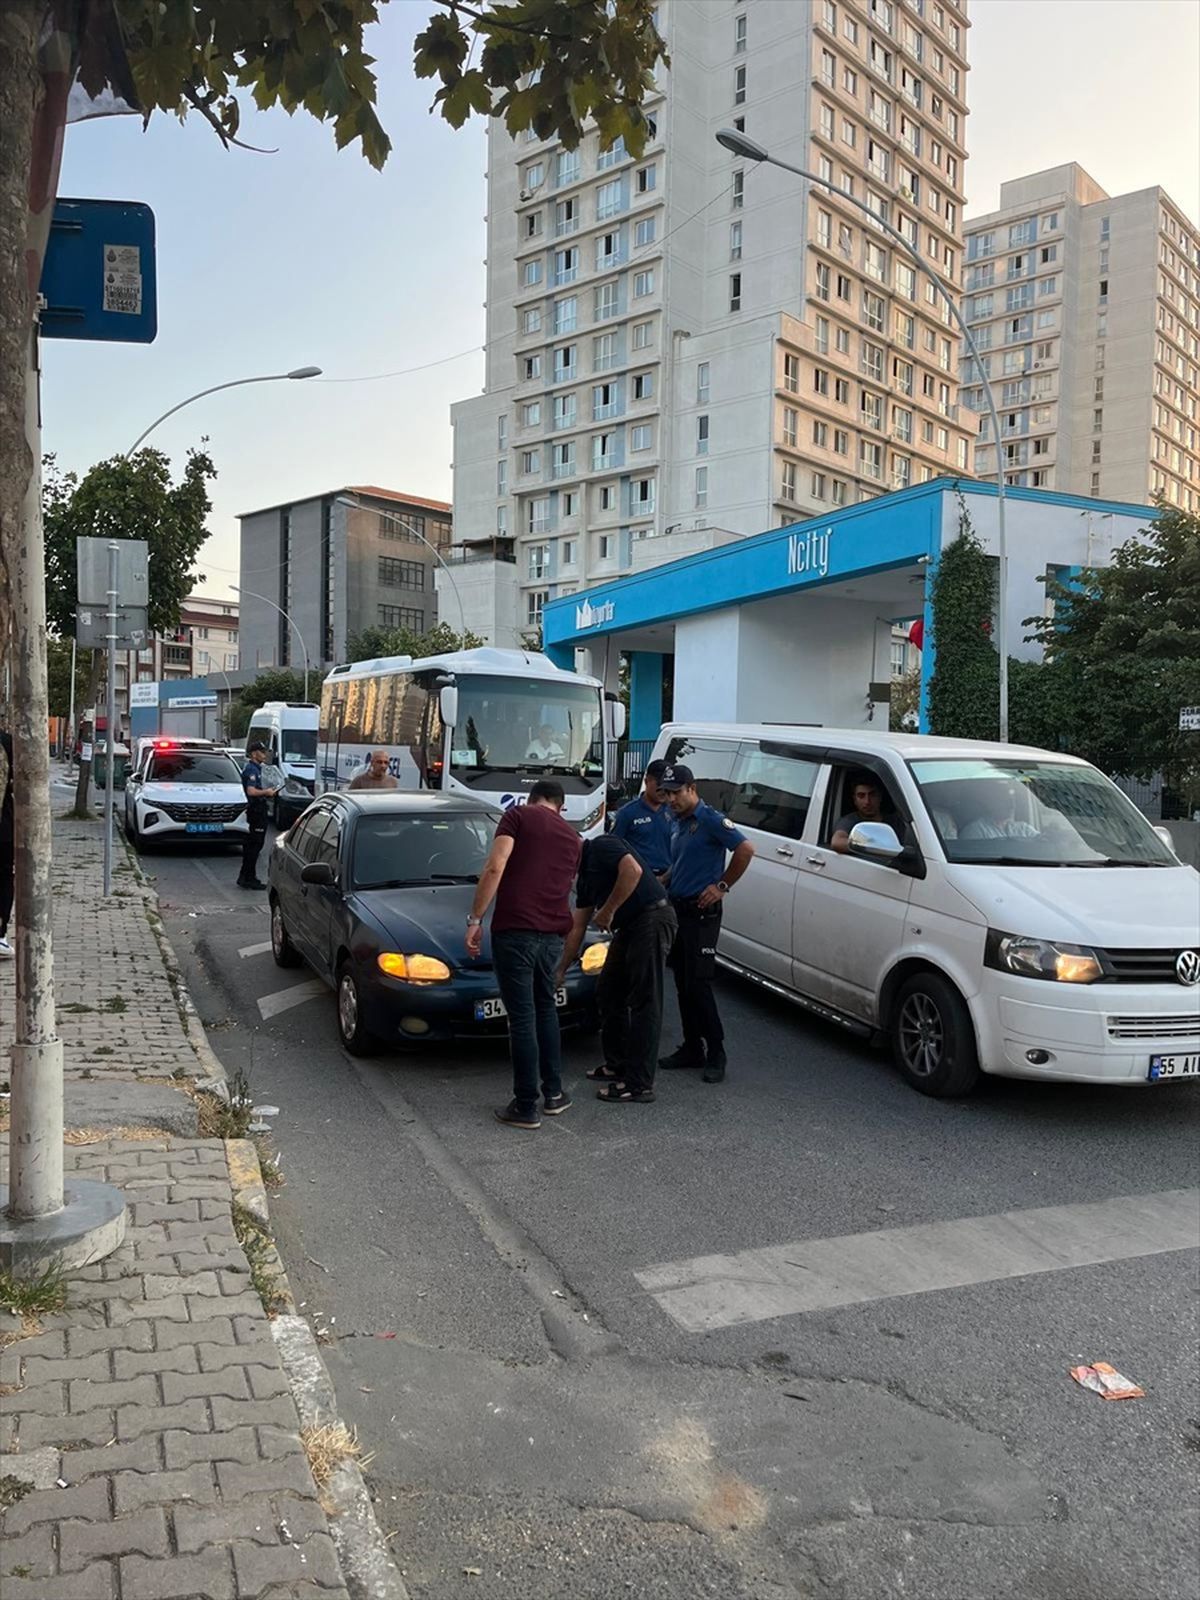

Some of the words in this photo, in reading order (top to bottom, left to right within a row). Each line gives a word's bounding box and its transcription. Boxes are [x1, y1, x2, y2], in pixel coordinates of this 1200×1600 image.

[788, 529, 831, 576] Ncity
[484, 1000, 501, 1017] 34
[1159, 1058, 1175, 1075] 55
